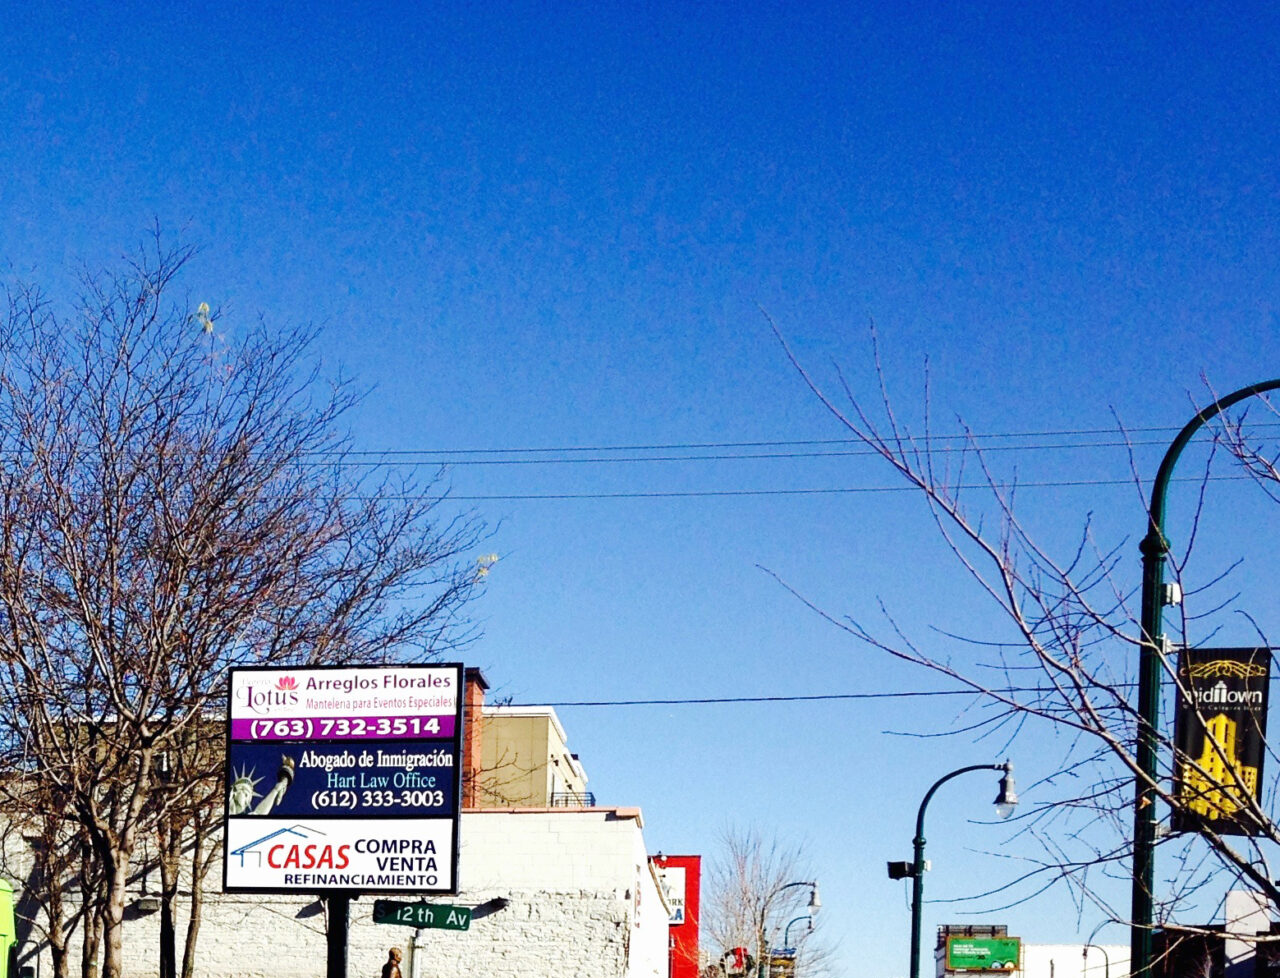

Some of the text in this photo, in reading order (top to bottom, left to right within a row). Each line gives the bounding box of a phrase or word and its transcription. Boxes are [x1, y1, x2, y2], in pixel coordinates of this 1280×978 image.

[236, 674, 451, 715] Lotus Arreglos Florales
[352, 699, 371, 712] para
[373, 697, 407, 710] Eventos
[408, 695, 452, 711] Especiales
[250, 718, 441, 739] (763) 732-3514
[299, 749, 454, 772] Abogado de Inmigración
[327, 772, 436, 789] Hart Law Office
[311, 790, 444, 810] (612) 333-3003
[267, 839, 437, 870] CASAS COMPRA
[376, 857, 438, 872] VENTA
[284, 874, 438, 886] REFINANCIAMIENTO
[396, 906, 434, 924] 12th
[446, 910, 467, 927] Av
